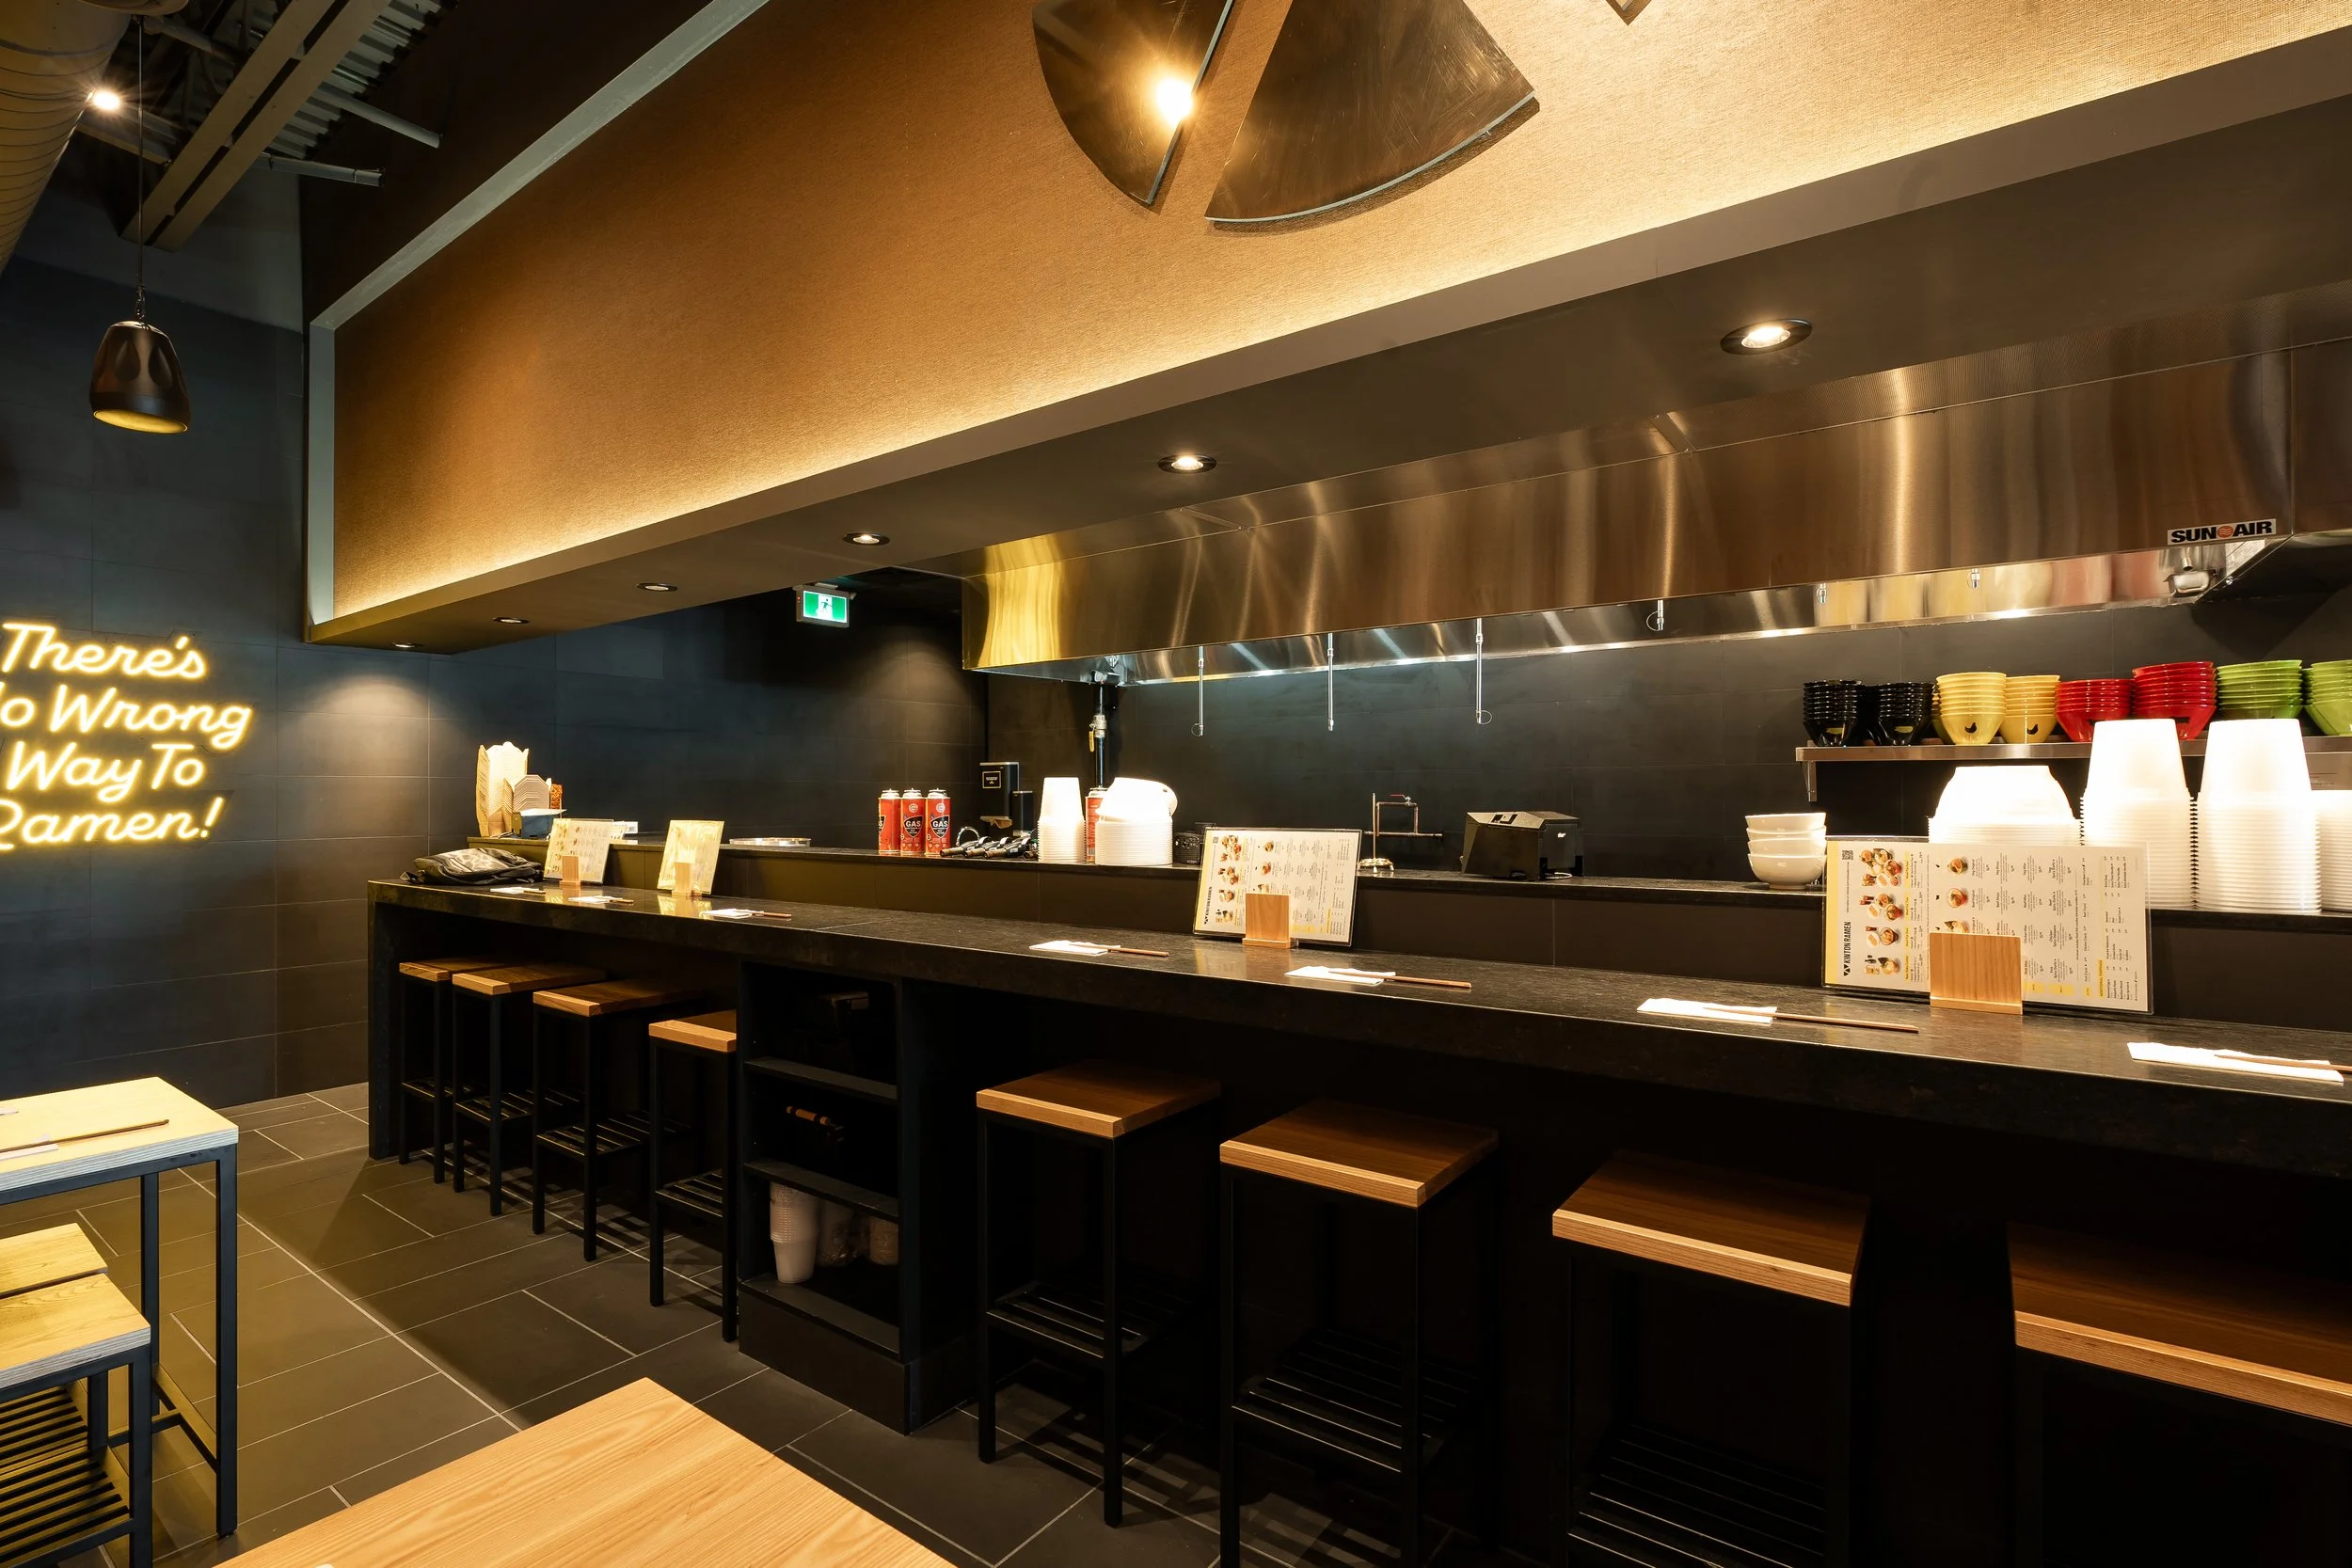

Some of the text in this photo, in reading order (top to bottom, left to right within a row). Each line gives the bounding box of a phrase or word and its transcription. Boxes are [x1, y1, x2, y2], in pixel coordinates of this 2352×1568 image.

[2170, 520, 2272, 544] SUN AIR
[2, 622, 206, 678] There's
[0, 681, 252, 750] o Wrong
[6, 740, 204, 802] Way To
[1843, 921, 1851, 942] RAMEN
[1843, 942, 1851, 964] KINTON
